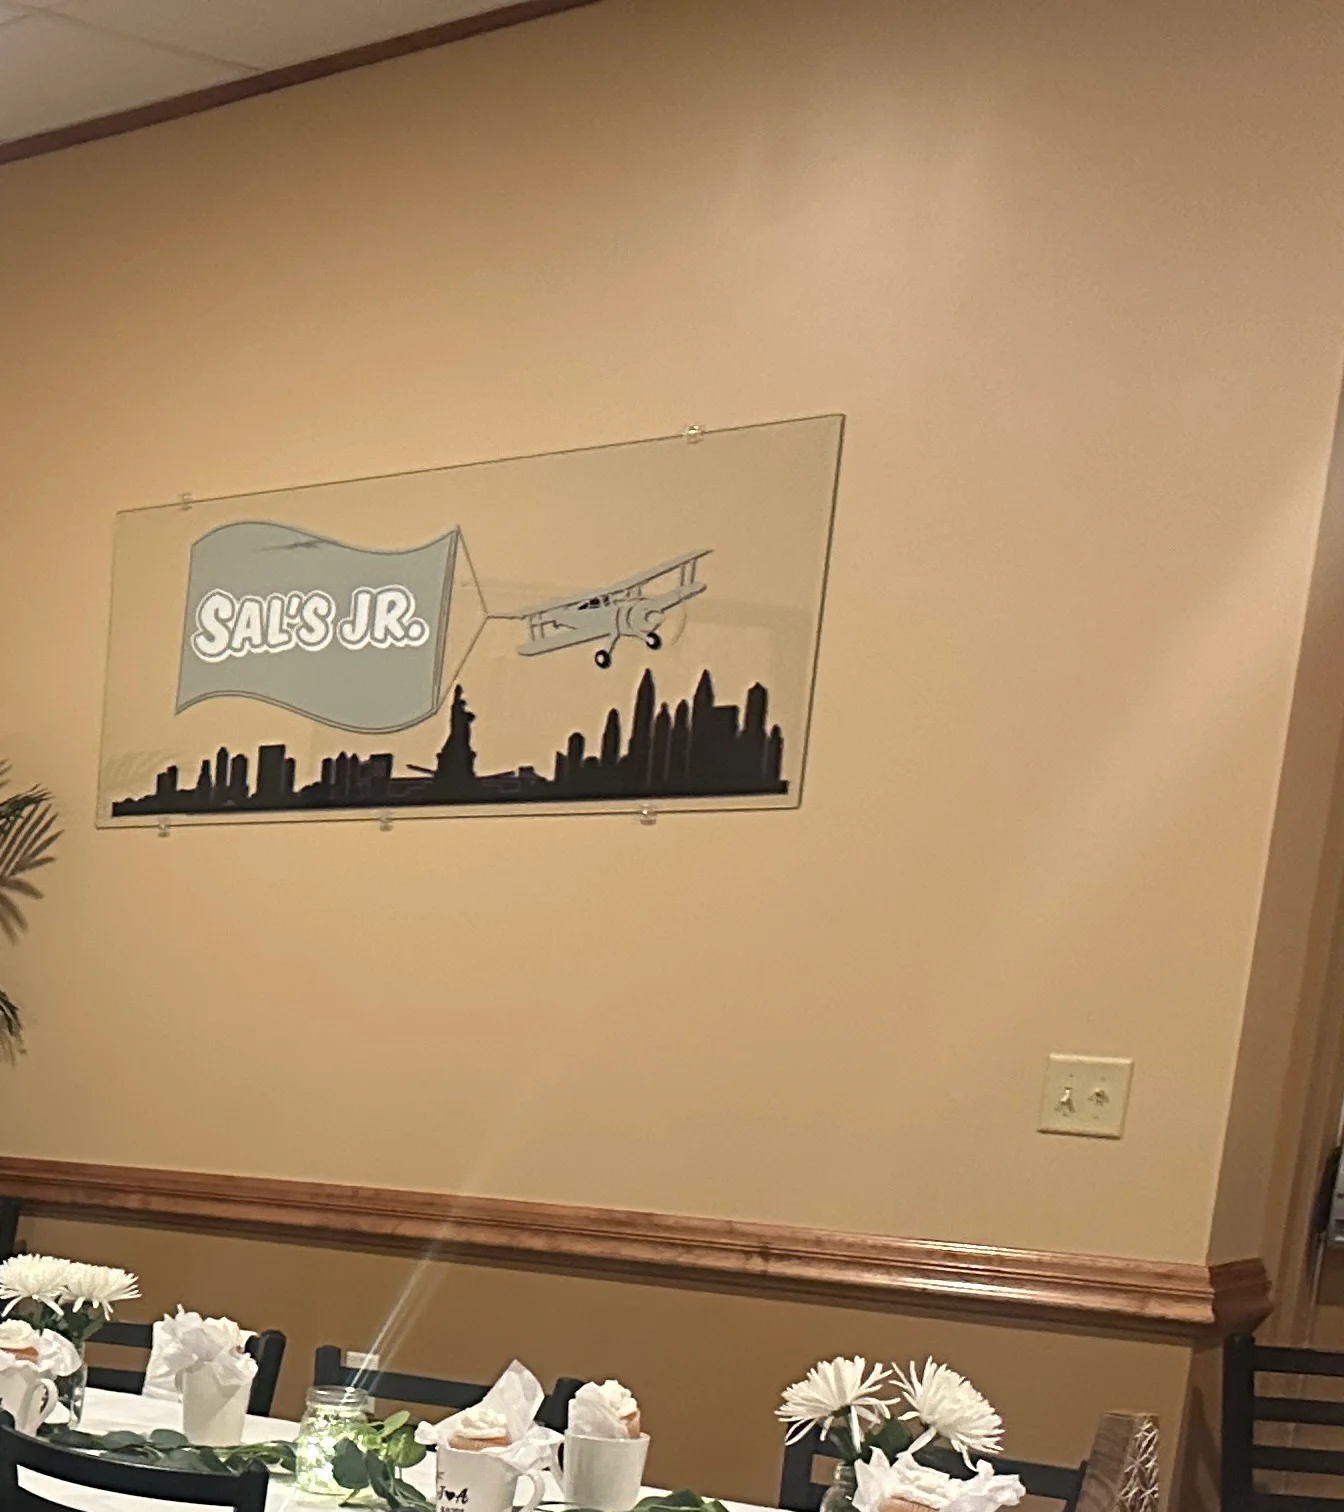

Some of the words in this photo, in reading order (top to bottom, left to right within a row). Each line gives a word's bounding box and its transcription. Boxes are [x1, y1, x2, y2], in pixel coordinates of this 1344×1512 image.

[191, 588, 336, 663] SAL'S
[337, 585, 430, 650] JR.
[455, 1488, 470, 1505] A
